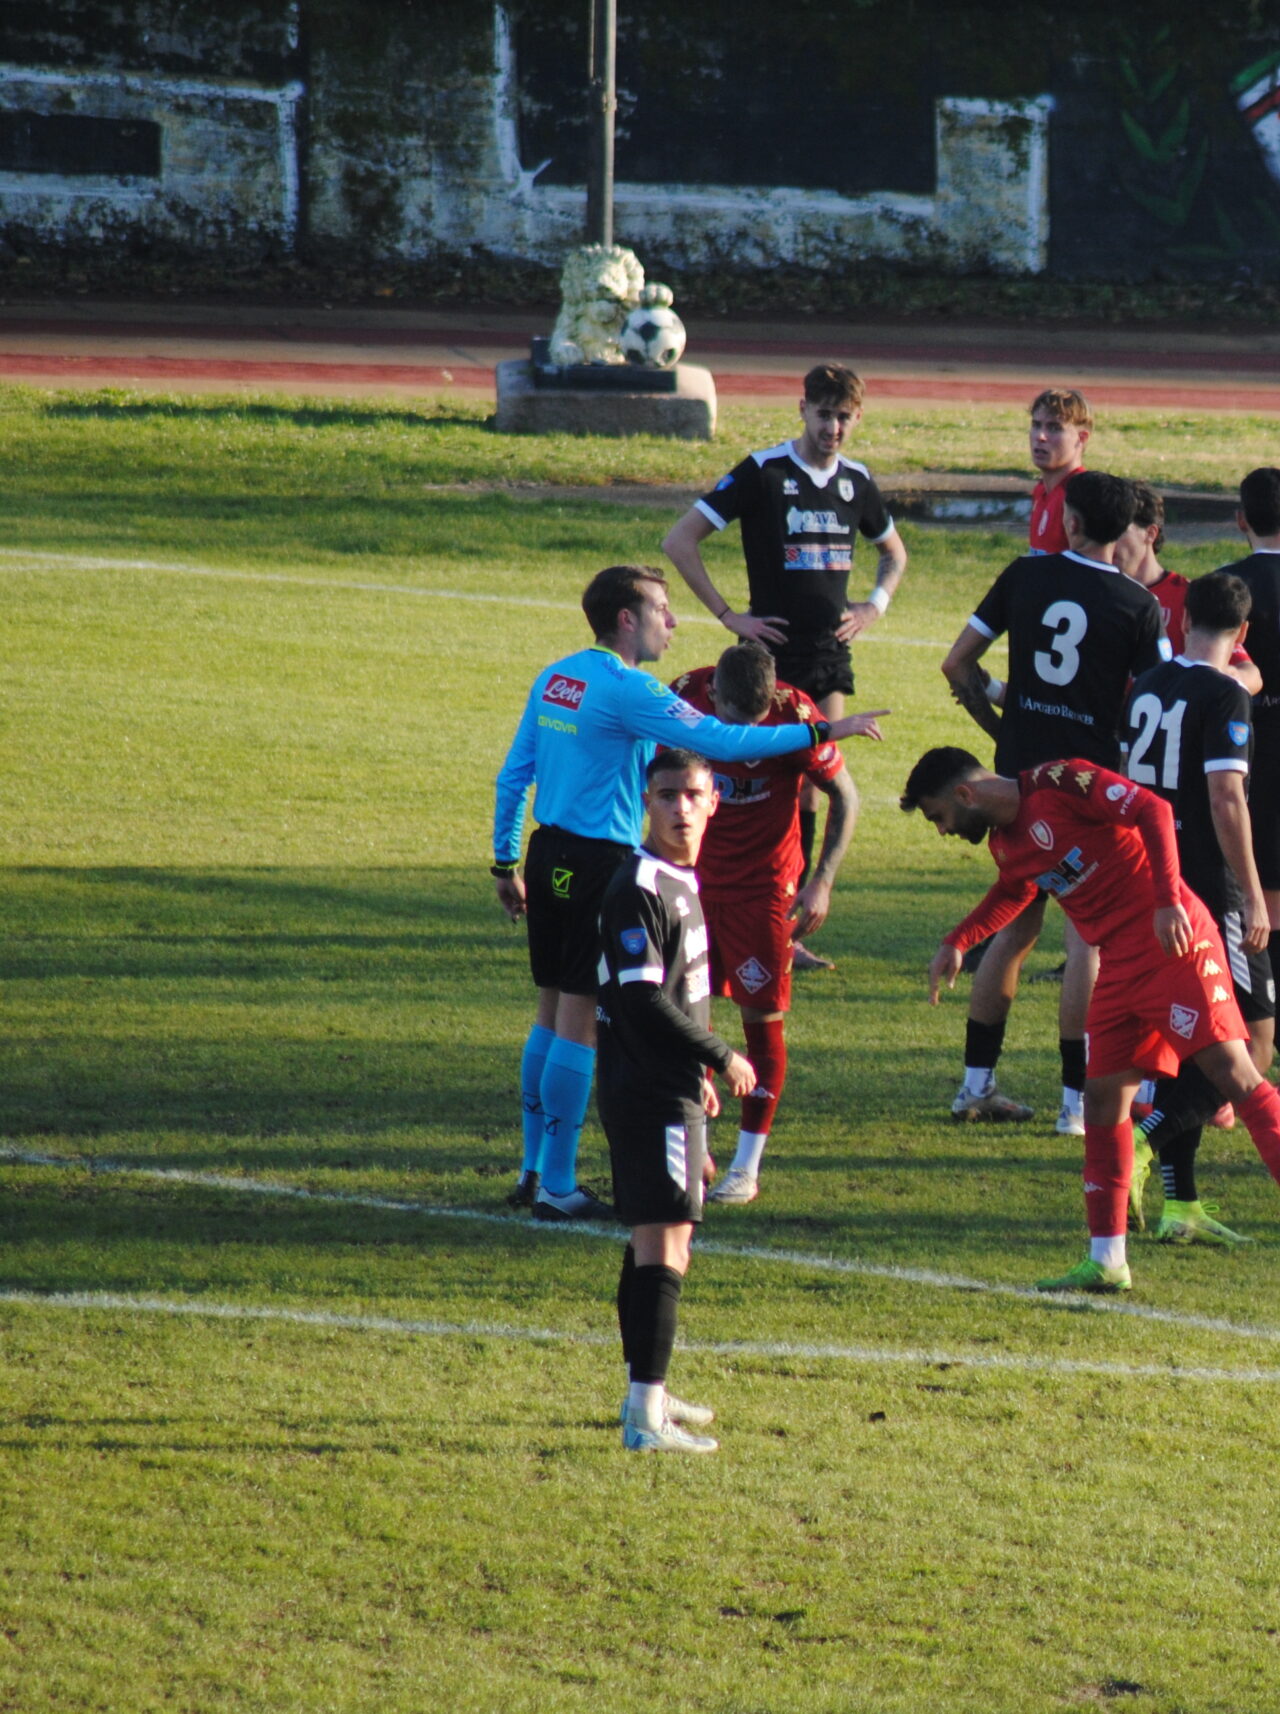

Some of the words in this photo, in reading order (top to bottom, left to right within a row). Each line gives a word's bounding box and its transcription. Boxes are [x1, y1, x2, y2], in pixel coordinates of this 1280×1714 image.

[1034, 600, 1087, 686] 3
[545, 679, 583, 704] Lete
[1128, 693, 1187, 790] 21
